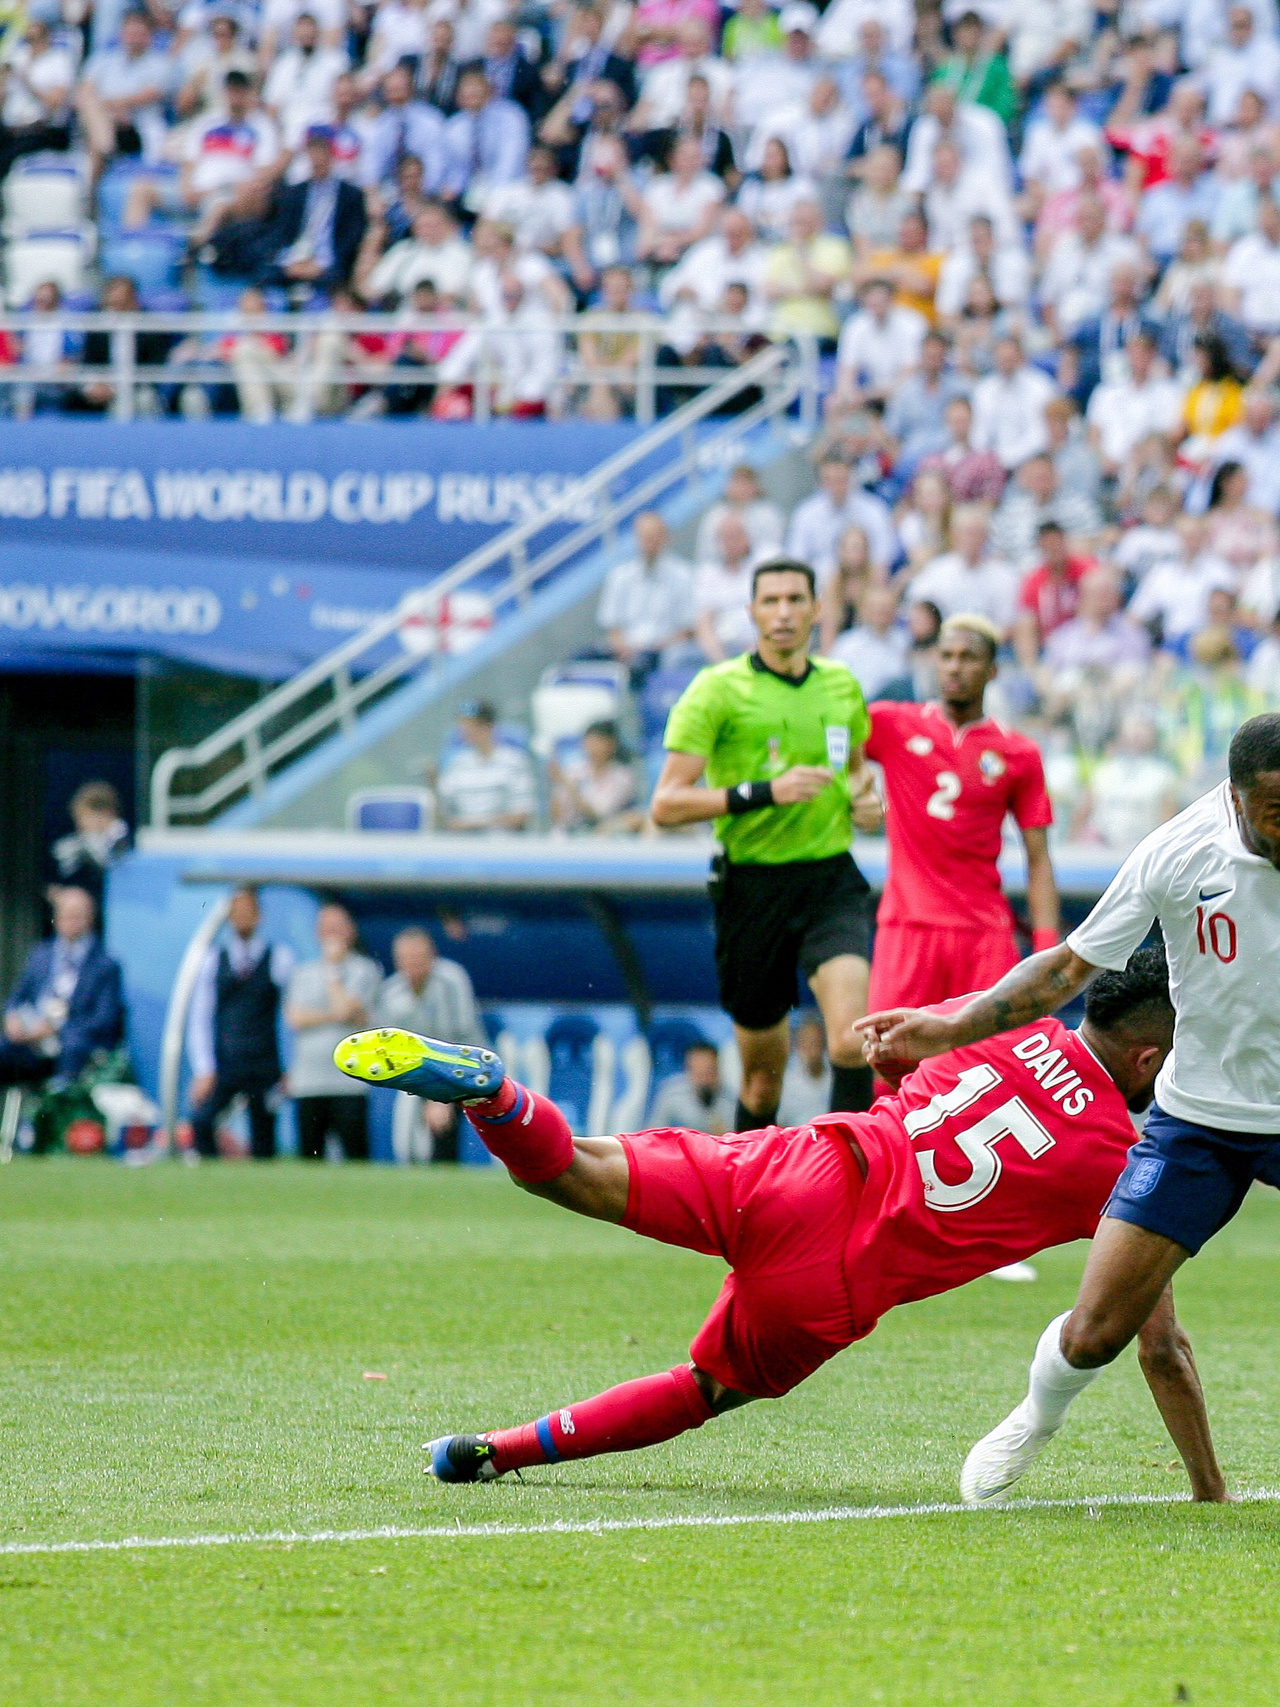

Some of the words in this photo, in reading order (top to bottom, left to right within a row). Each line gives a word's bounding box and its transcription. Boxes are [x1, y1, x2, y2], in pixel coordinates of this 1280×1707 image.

[50, 469, 150, 521] FIFA
[153, 470, 328, 523] WORLD
[330, 471, 434, 524] CUP
[0, 582, 222, 636] OVGOROD
[926, 771, 961, 821] 2
[1196, 905, 1237, 964] 10
[1011, 1031, 1096, 1117] DAVIS
[902, 1062, 1058, 1213] 15
